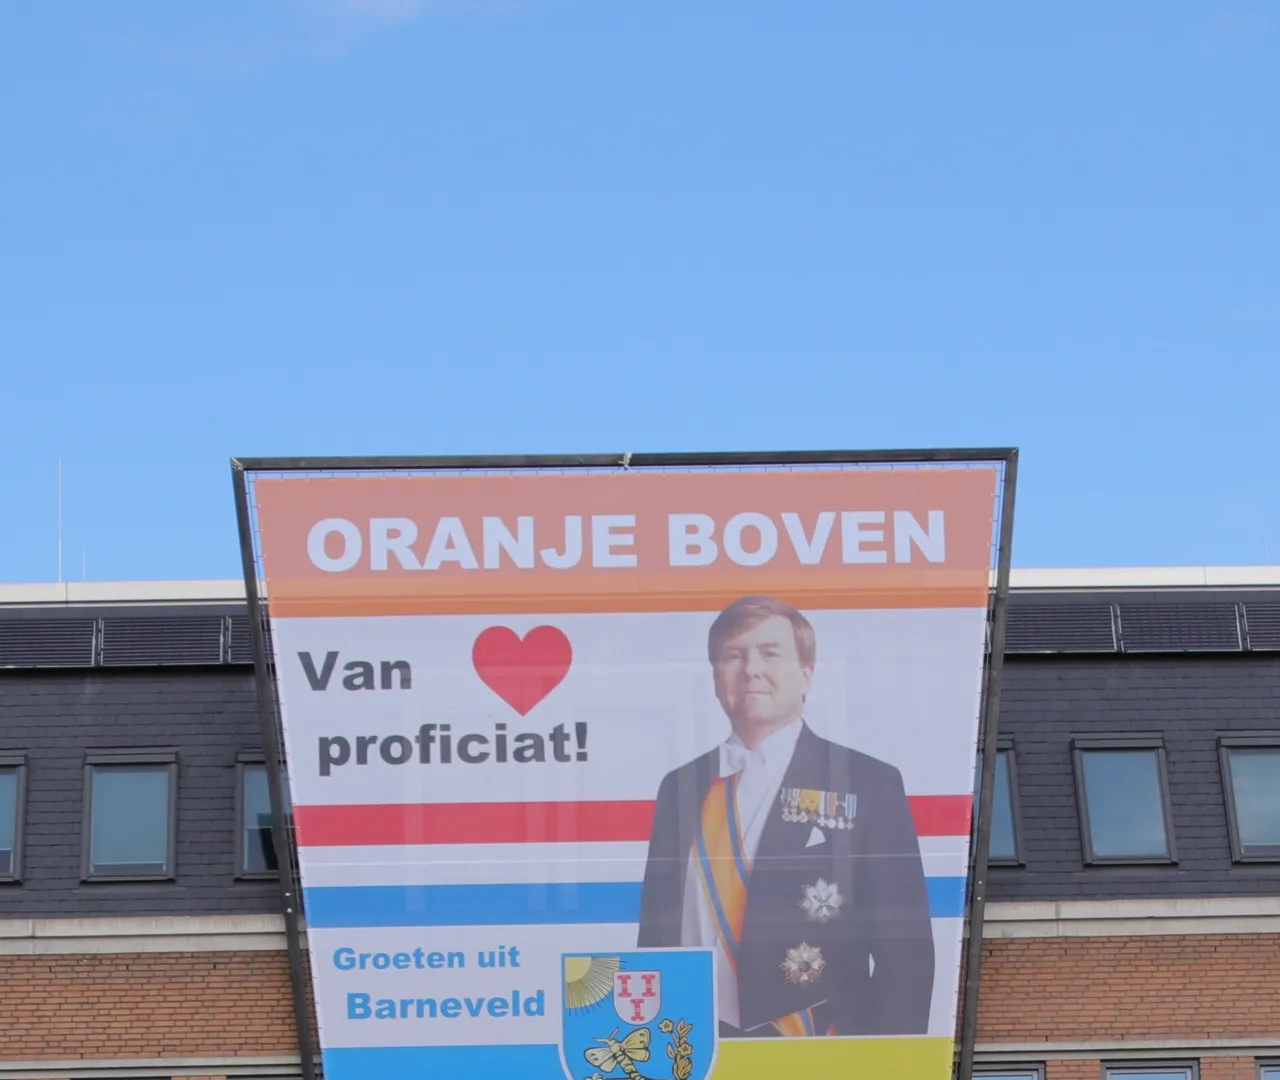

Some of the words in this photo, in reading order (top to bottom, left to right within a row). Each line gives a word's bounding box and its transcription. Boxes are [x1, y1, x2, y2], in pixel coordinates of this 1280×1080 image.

[307, 513, 638, 571] ORANJE
[668, 510, 945, 567] BOVEN
[297, 651, 412, 692] Van
[317, 722, 589, 776] proficiat!
[333, 947, 465, 971] Groeten
[476, 944, 520, 969] uit
[346, 990, 545, 1020] Barneveld
